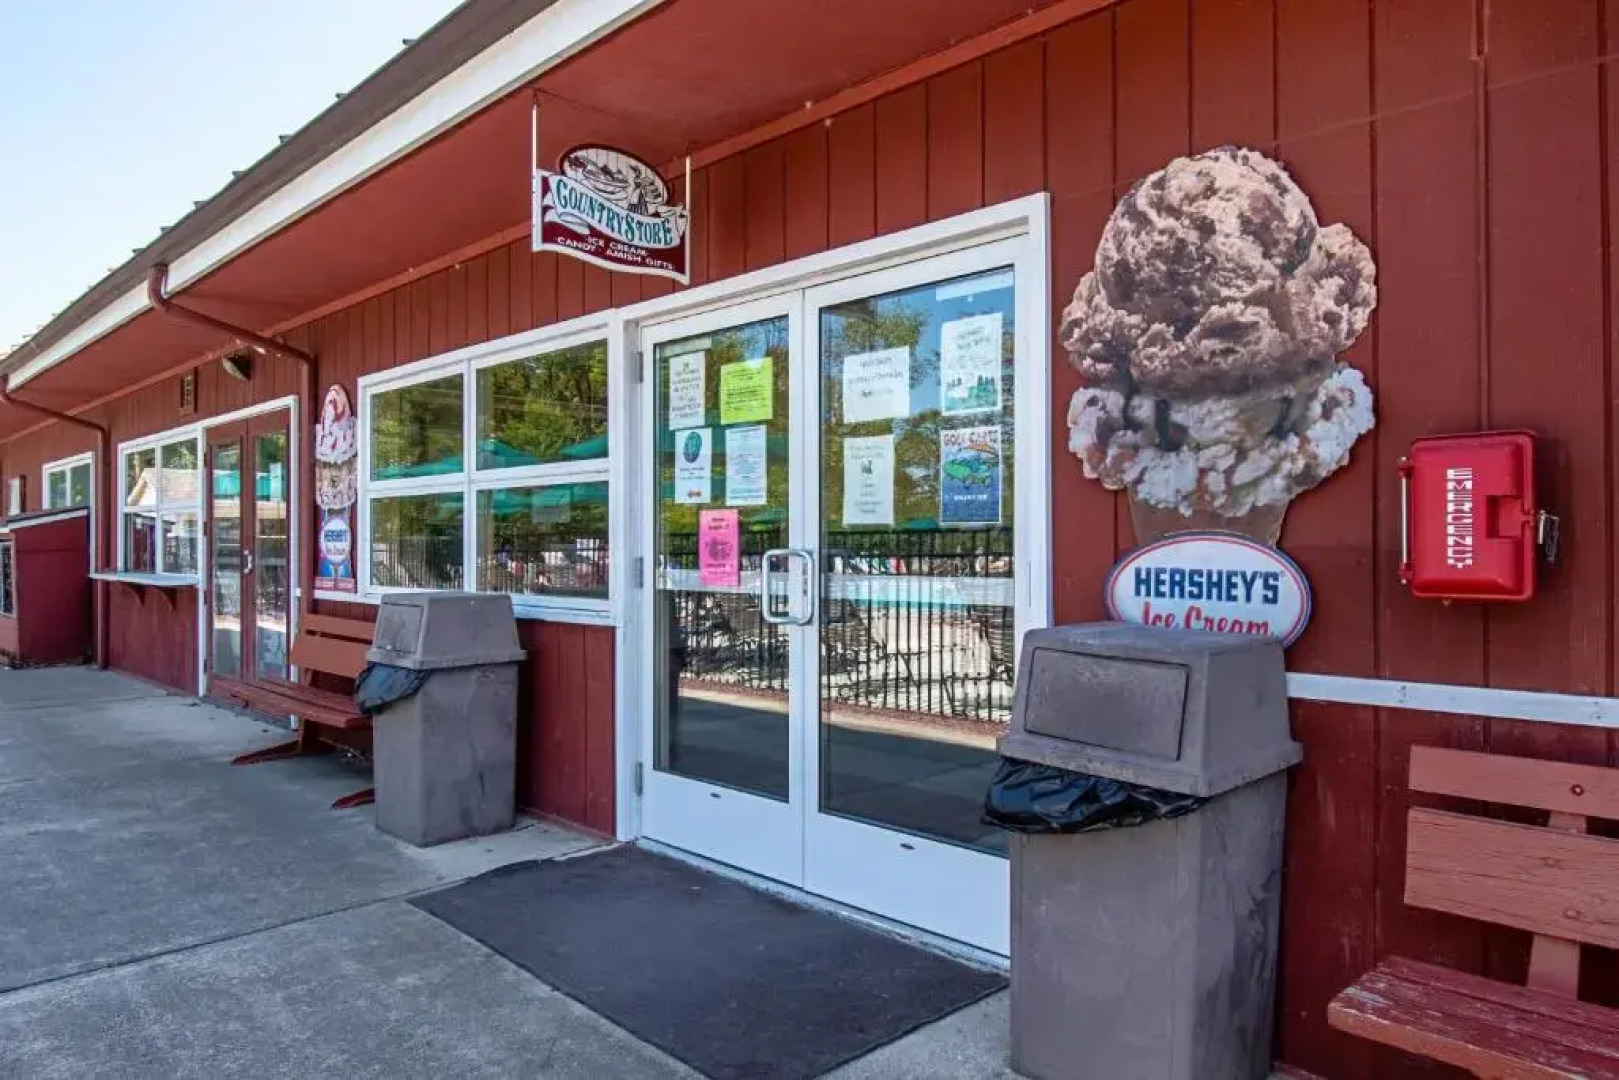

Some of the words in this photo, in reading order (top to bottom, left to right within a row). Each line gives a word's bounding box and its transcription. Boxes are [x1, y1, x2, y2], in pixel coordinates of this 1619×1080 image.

[556, 179, 624, 237] COUNTRY
[625, 212, 673, 246] STORE
[557, 236, 596, 252] CANDY
[605, 249, 641, 263] AMISH
[645, 258, 673, 270] GIFTS
[610, 243, 646, 255] CREAM
[1446, 467, 1473, 569] EMERGENCY
[1134, 567, 1280, 605] HERSHEY'S
[1142, 601, 1177, 627] Ice
[1185, 605, 1269, 636] Cream
